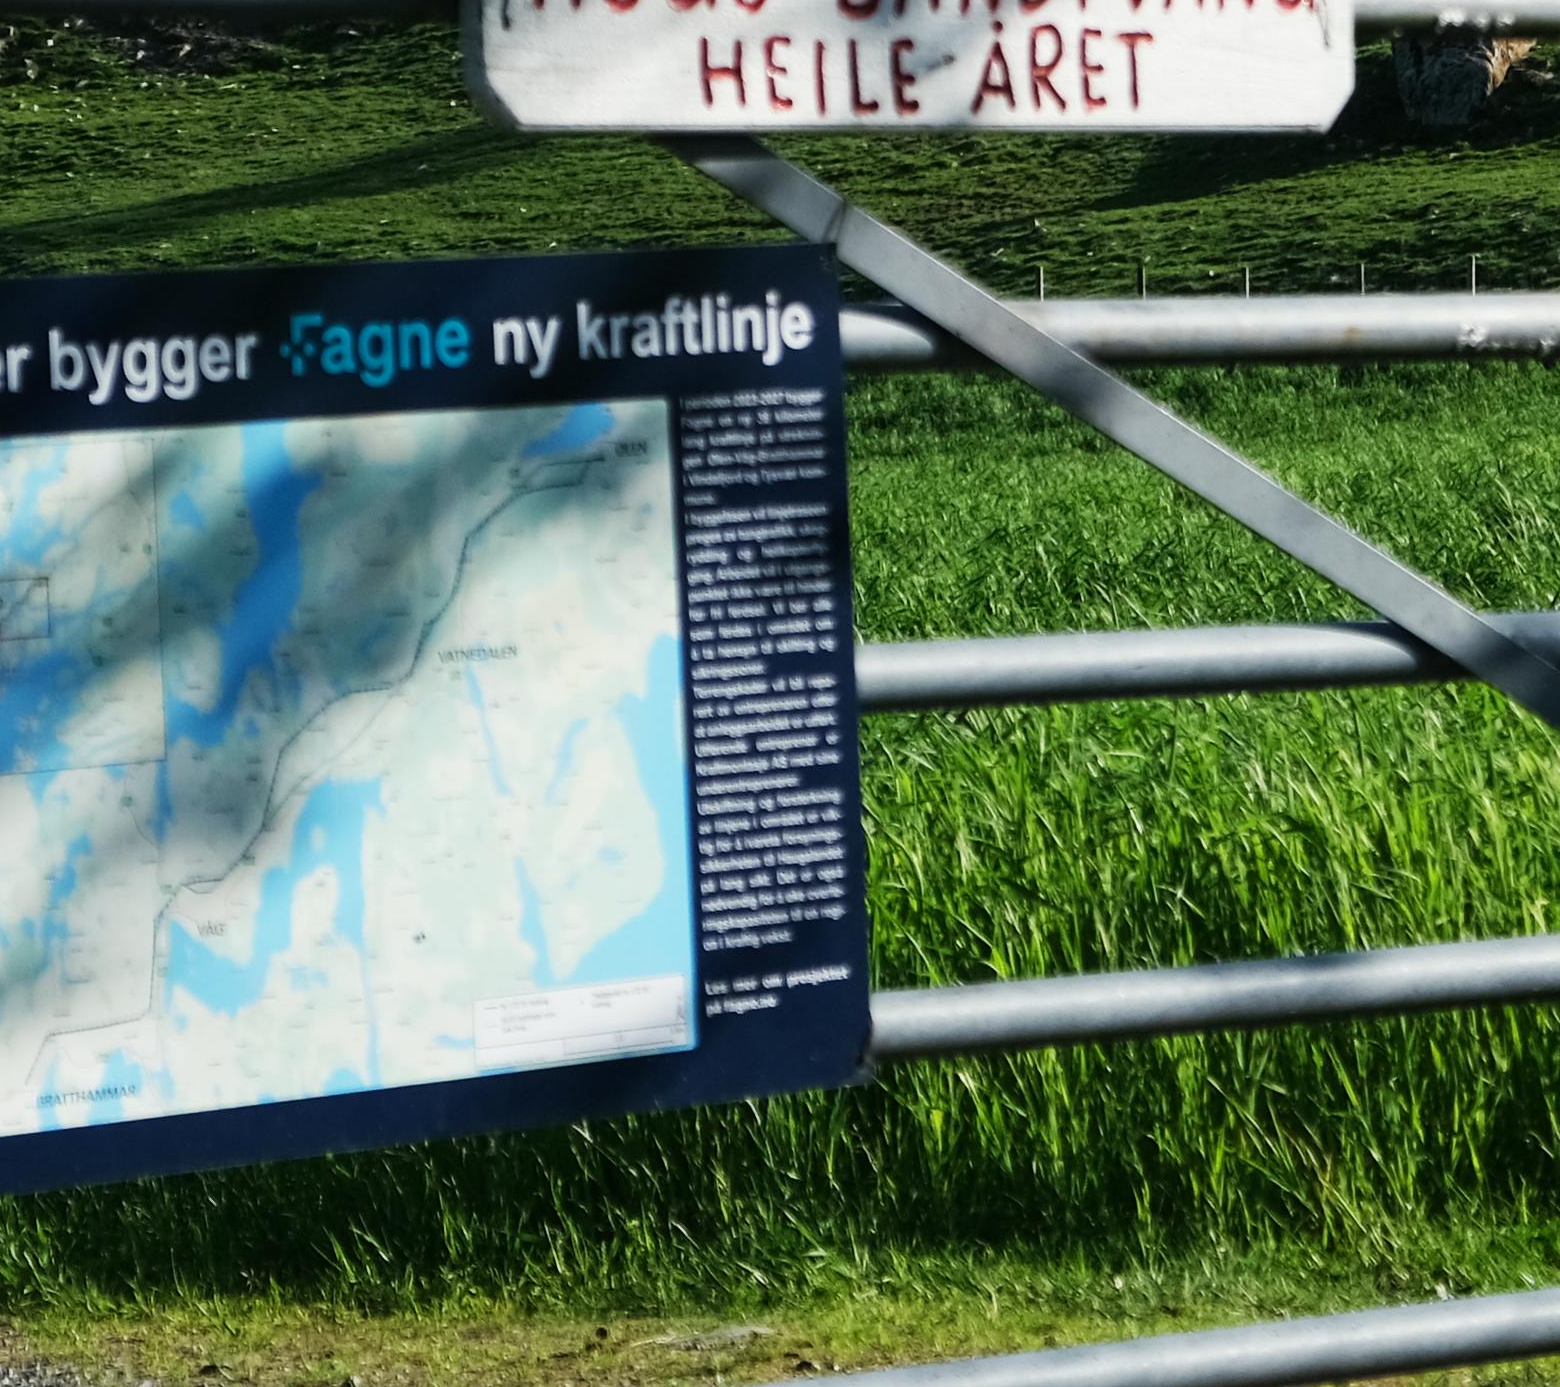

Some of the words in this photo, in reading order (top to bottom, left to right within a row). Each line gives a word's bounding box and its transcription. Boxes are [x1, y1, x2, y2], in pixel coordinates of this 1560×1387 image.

[700, 35, 919, 115] HEILE
[971, 21, 1155, 114] ÅRET
[48, 328, 258, 406] bygger
[281, 313, 472, 388] Fagne
[493, 316, 561, 379] ny
[576, 290, 815, 367] kraftlinje
